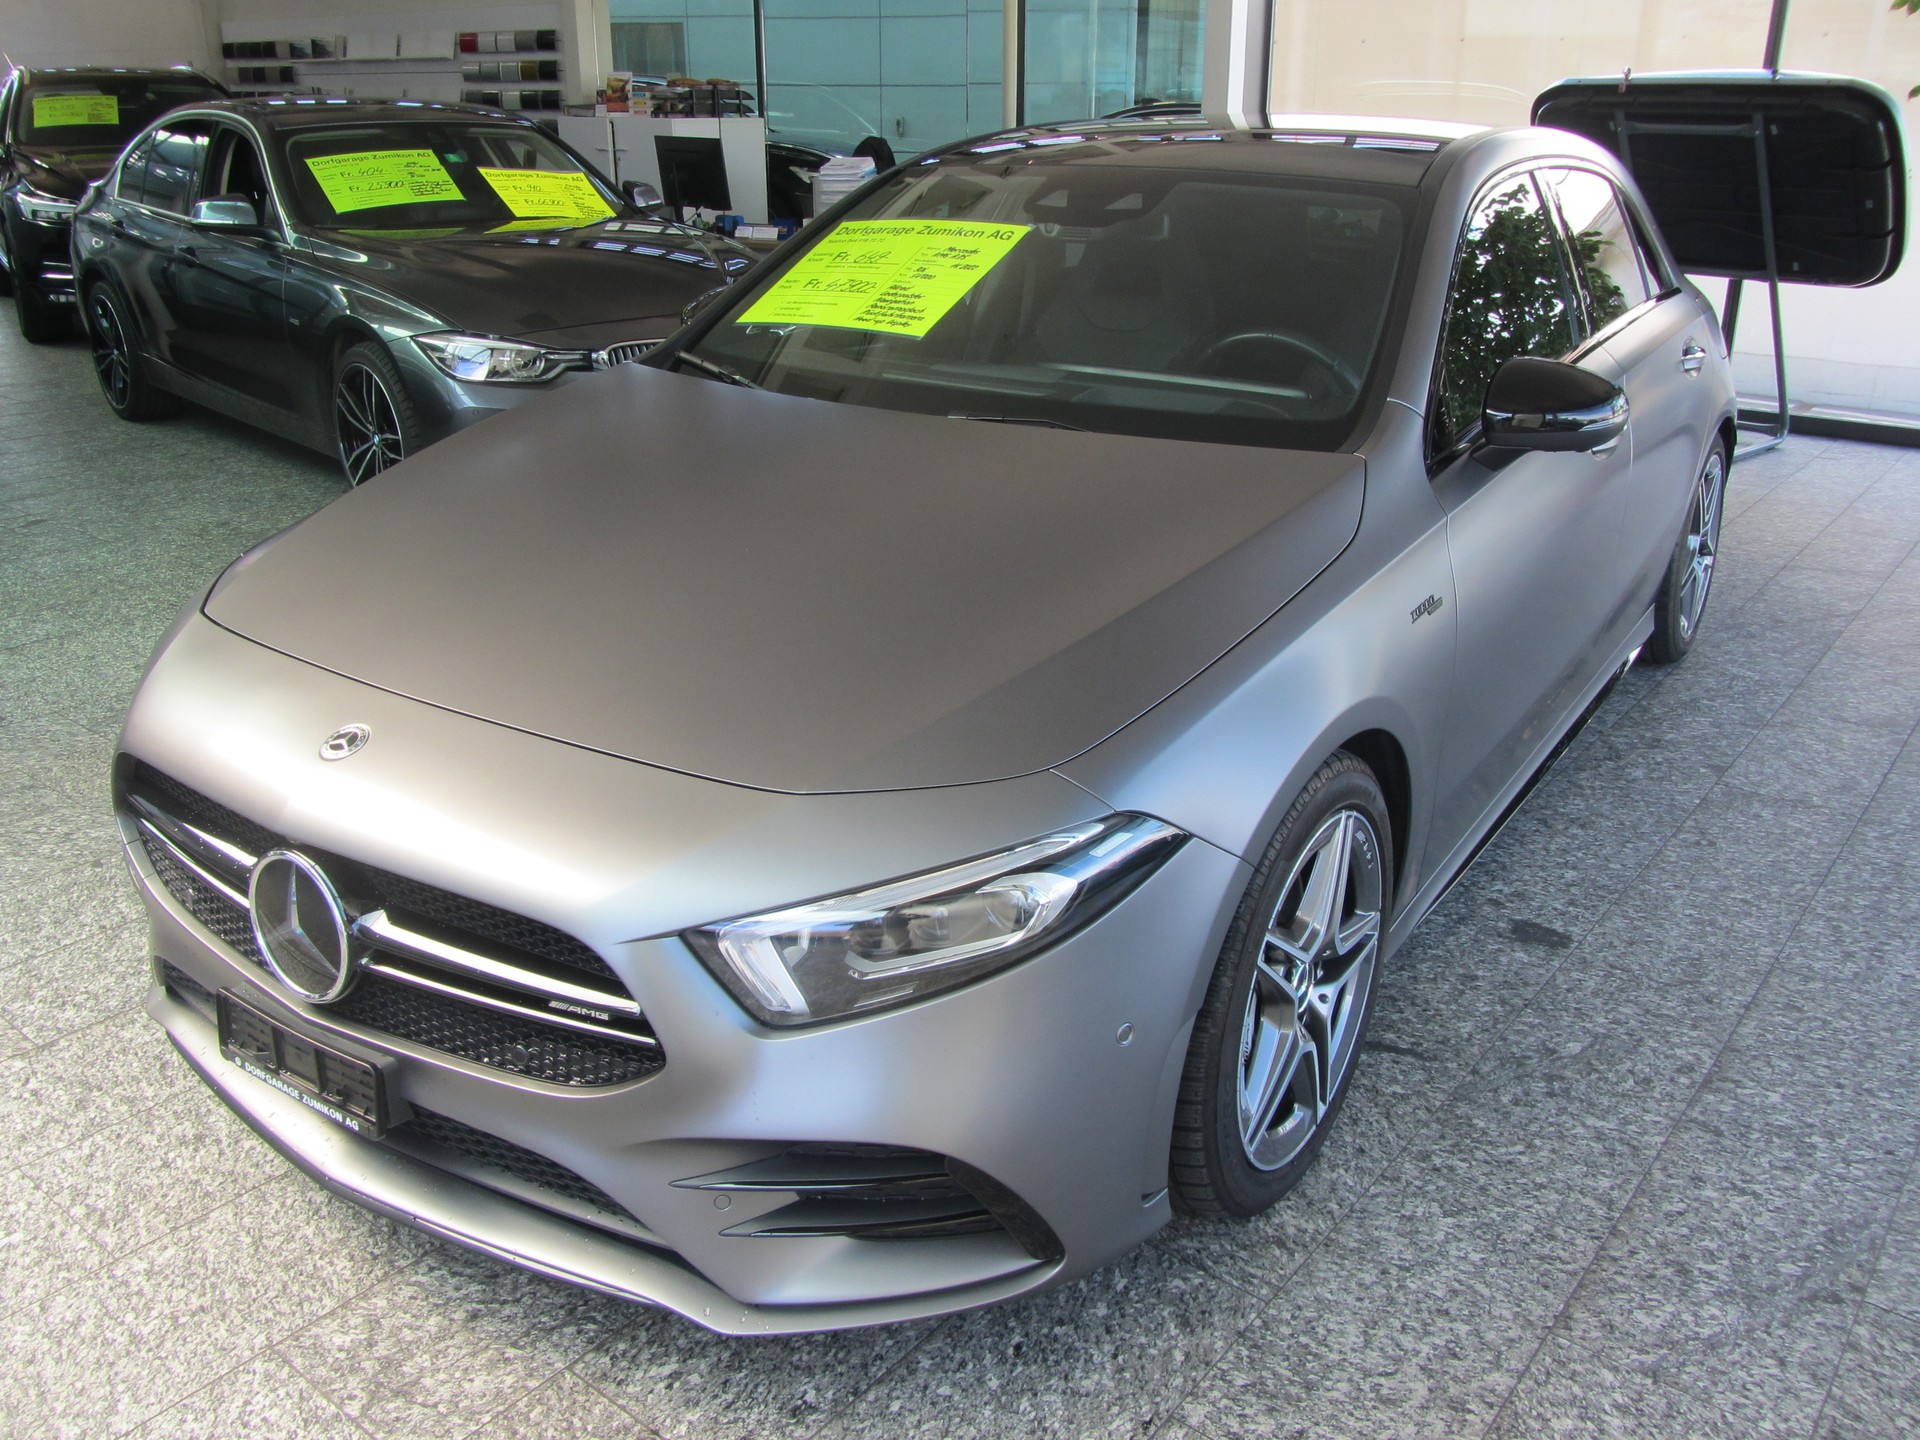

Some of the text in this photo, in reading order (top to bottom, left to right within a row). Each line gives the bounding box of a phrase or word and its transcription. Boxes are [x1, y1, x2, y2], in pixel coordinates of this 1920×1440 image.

[312, 156, 370, 166] Dorfgarage
[485, 171, 533, 179] Dorfgarage
[836, 226, 1014, 240] Dorfgarage Zumikon AG
[832, 251, 850, 261] Fr.
[803, 278, 820, 288] Fr.
[245, 1062, 359, 1131] DORFGARAGE ZUMIKON AG
